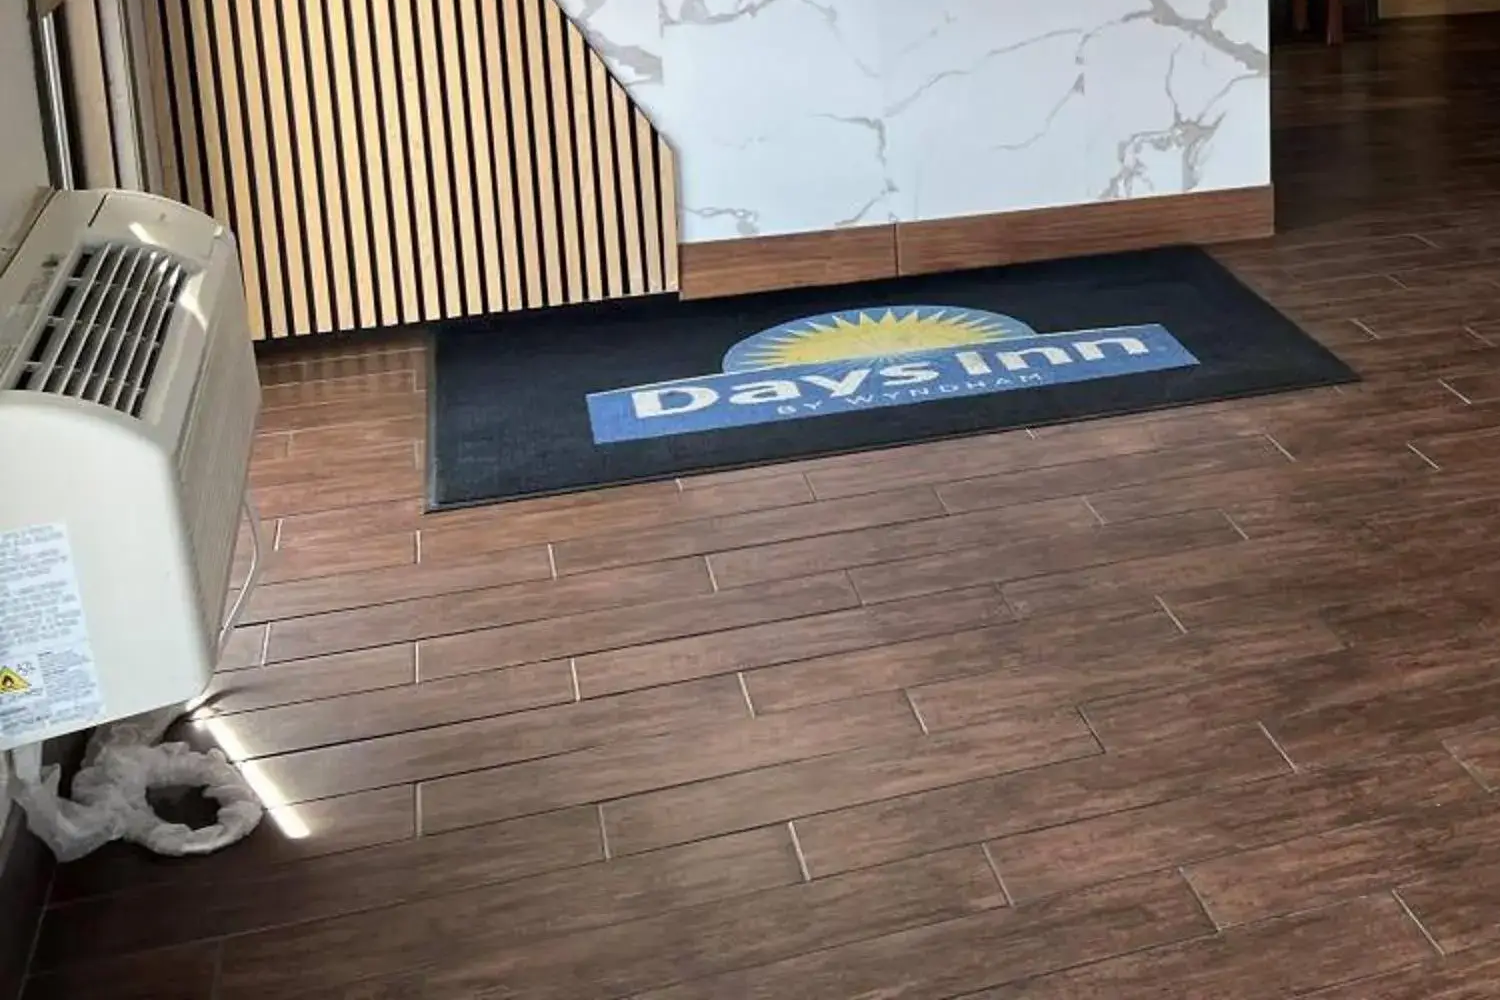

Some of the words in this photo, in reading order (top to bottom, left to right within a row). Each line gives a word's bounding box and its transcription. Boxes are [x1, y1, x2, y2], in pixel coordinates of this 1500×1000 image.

[631, 361, 940, 418] Days
[955, 337, 1149, 375] Inn
[776, 400, 824, 415] BY
[845, 373, 1042, 405] WYNDHAM
